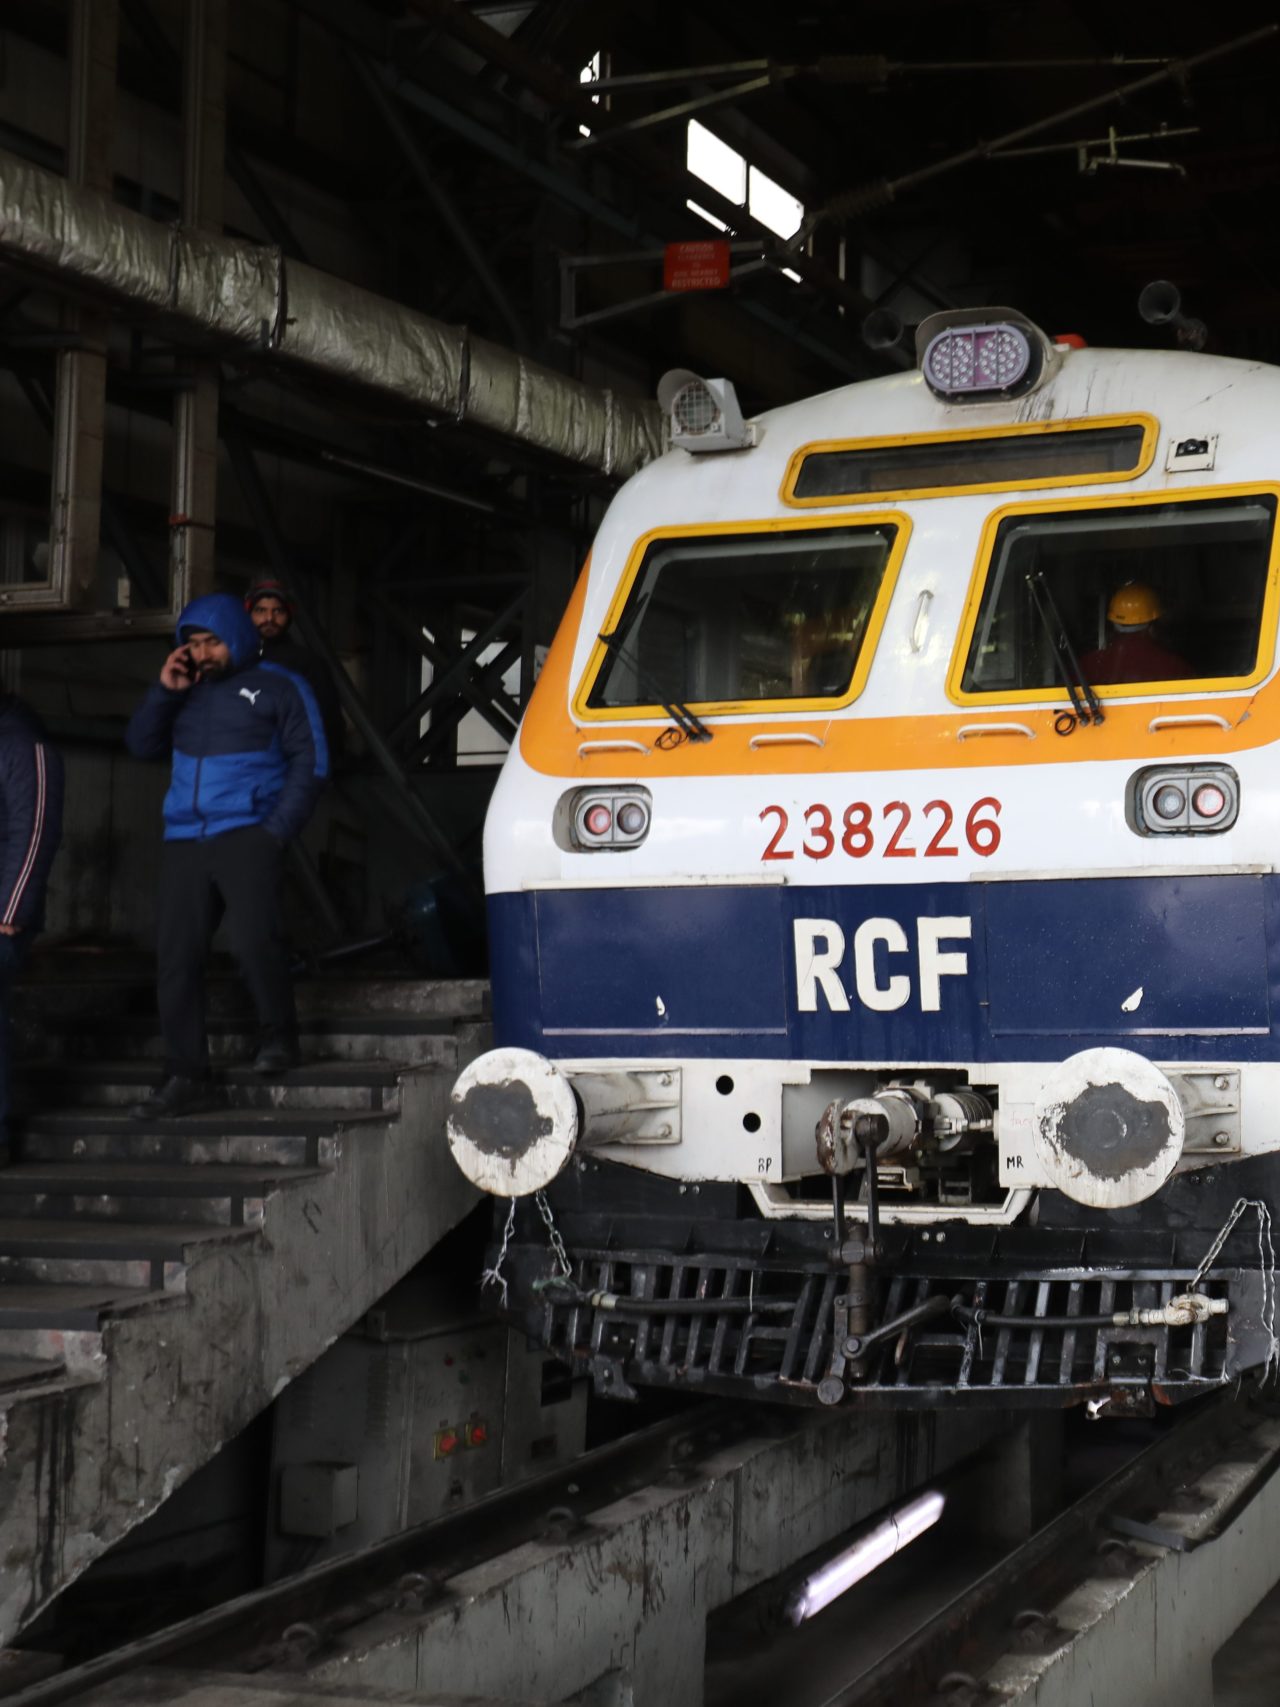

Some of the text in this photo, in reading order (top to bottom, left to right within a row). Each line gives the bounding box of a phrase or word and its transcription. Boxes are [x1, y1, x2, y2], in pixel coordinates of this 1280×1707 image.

[672, 276, 721, 289] RESTRICTED
[759, 797, 1002, 861] 238226
[794, 916, 972, 1012] RCF
[1006, 1155, 1024, 1169] MR
